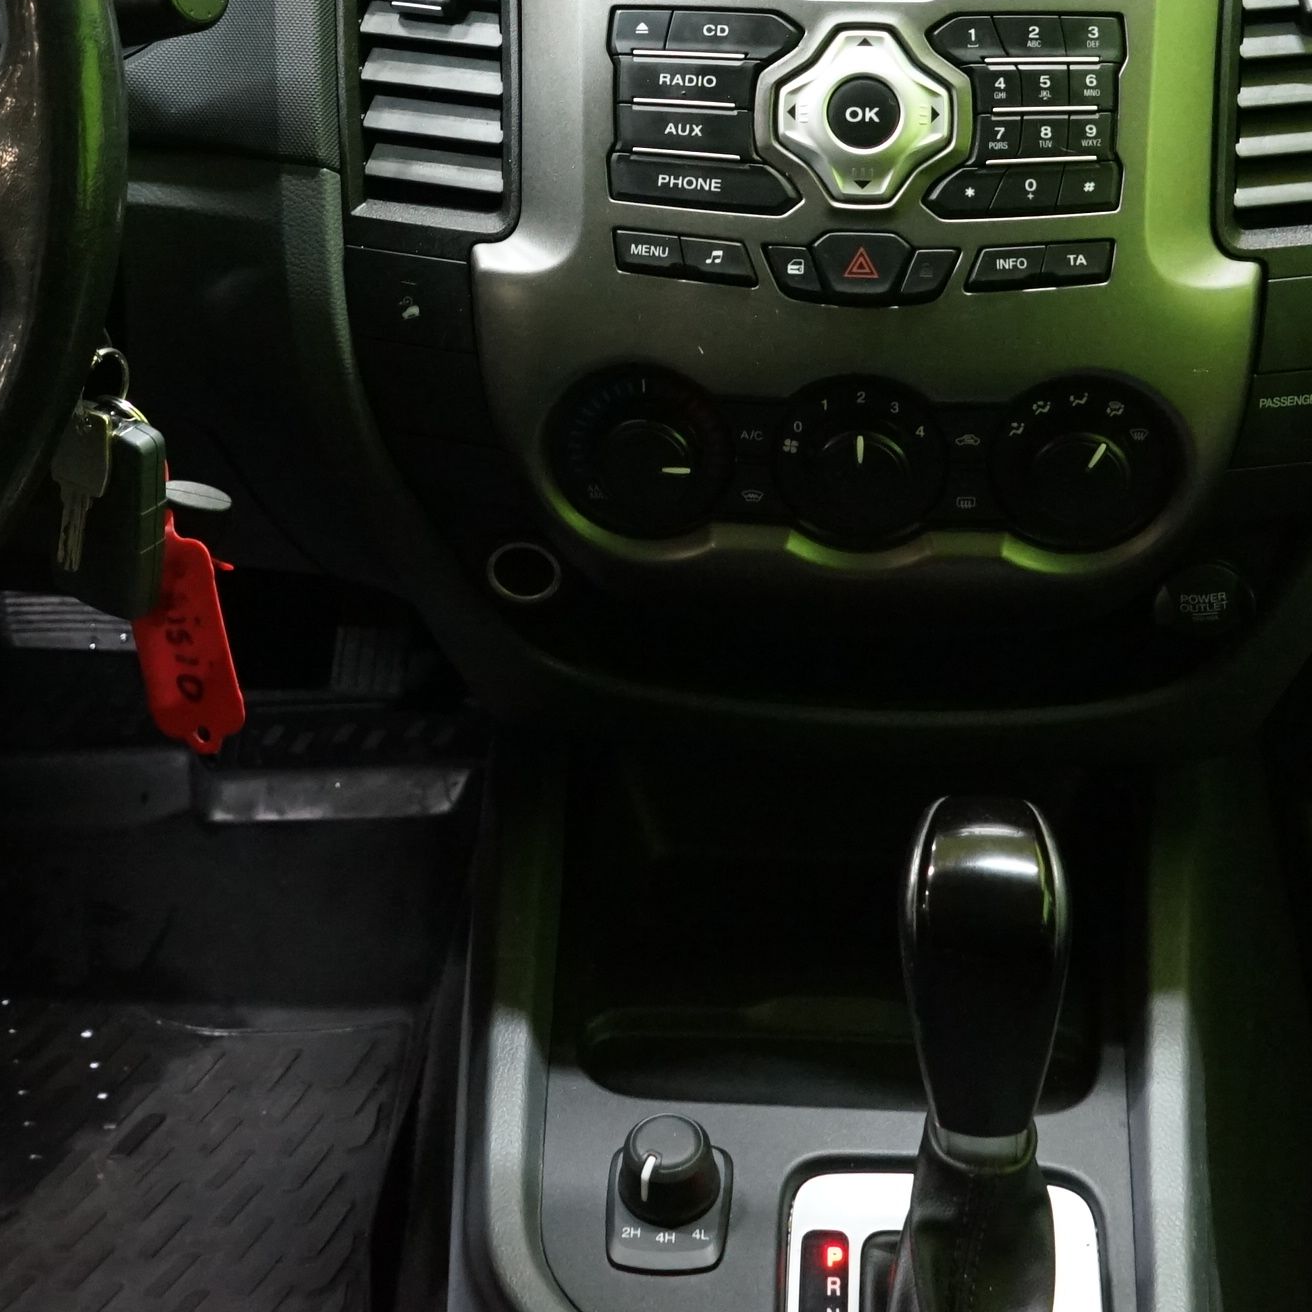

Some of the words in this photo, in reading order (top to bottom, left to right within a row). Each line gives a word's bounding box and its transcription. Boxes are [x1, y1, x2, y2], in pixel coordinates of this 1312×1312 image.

[702, 24, 729, 37] CD
[968, 28, 977, 41] 1
[1028, 26, 1039, 38] 2
[1087, 26, 1099, 38] 3
[1027, 40, 1042, 48] ABC
[1086, 40, 1100, 48] DEF
[659, 73, 717, 88] RADIO
[994, 77, 1006, 89] 4
[1039, 75, 1051, 88] 5
[1085, 74, 1097, 87] 6
[993, 91, 1006, 99] GHI
[1039, 90, 1052, 98] JKL
[1083, 89, 1100, 97] MNO
[845, 106, 880, 123] OK
[664, 122, 703, 137] AUX
[994, 127, 1005, 139] 7
[1040, 126, 1052, 138] 8
[1085, 124, 1097, 137] 9
[989, 141, 1008, 150] PQRS
[1039, 140, 1052, 148] TUV
[1081, 139, 1101, 147] WXYZ
[657, 174, 722, 192] PHONE
[1025, 178, 1036, 191] 0
[630, 243, 669, 258] MENU
[996, 256, 1028, 270] INFO
[1066, 254, 1087, 267] TA
[856, 391, 866, 404] 2
[821, 399, 828, 411] 1
[890, 401, 899, 413] 3
[793, 421, 802, 432] 0
[915, 426, 926, 438] 4
[740, 429, 763, 441] A/C
[1180, 592, 1226, 604] POWER
[1179, 600, 1228, 613] OUTLET
[621, 1227, 641, 1238] 2H
[655, 1232, 676, 1244] 4H
[691, 1229, 709, 1240] 4L
[827, 1246, 843, 1267] P
[827, 1276, 840, 1296] R
